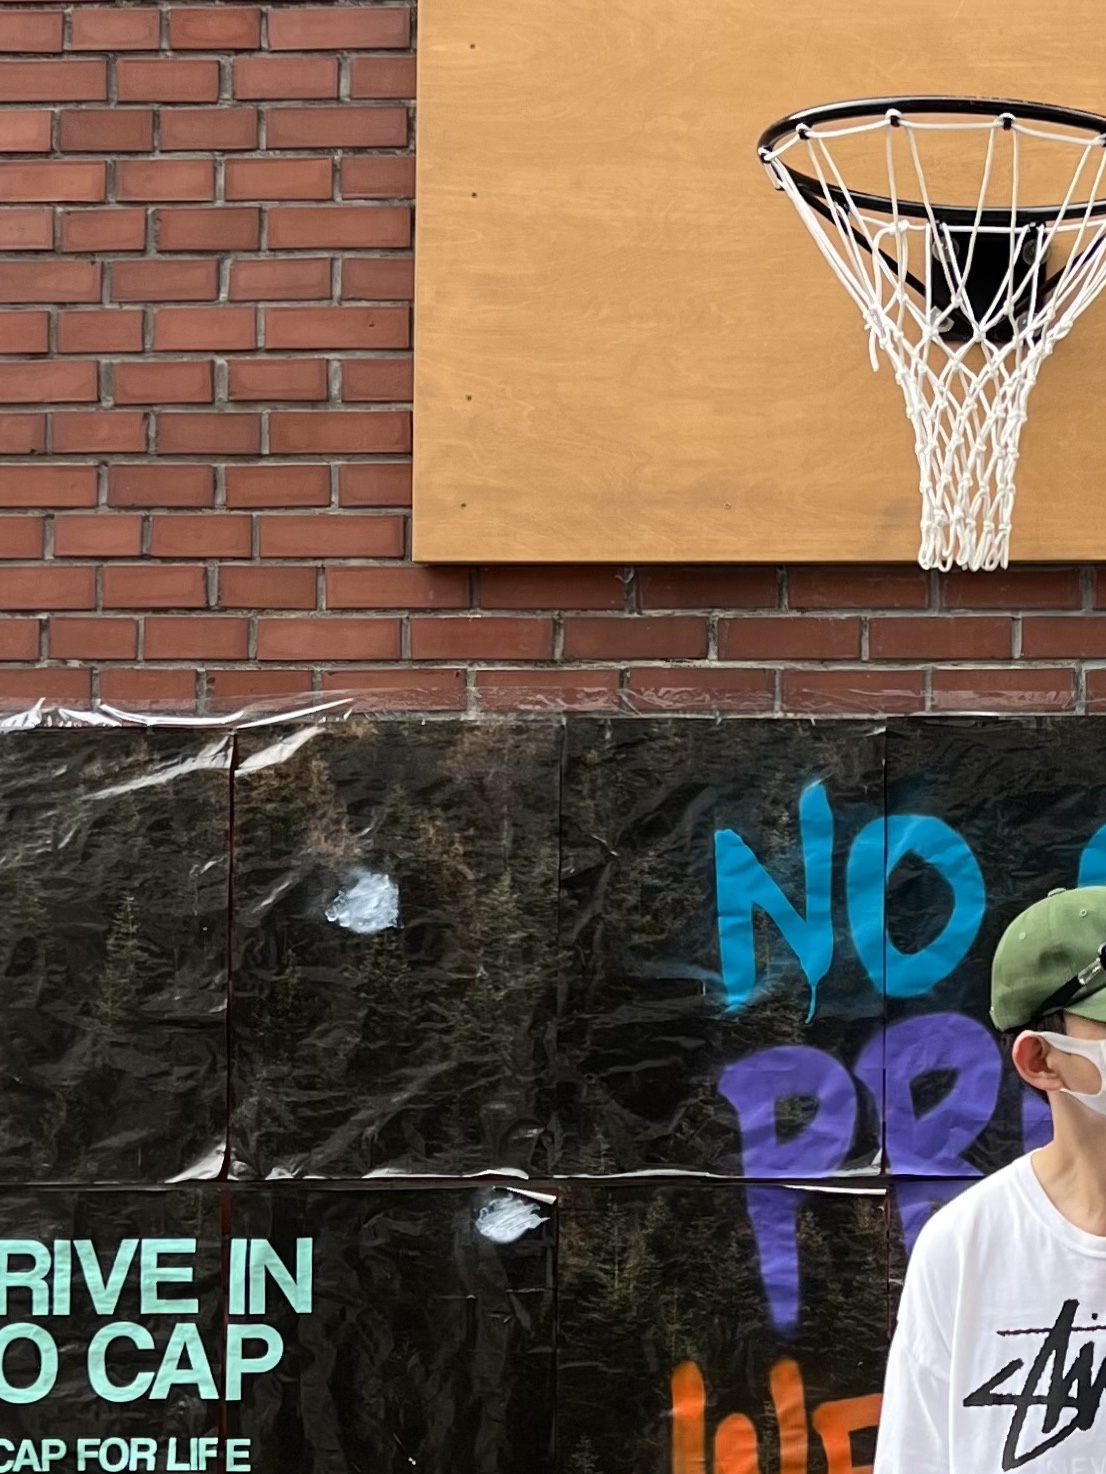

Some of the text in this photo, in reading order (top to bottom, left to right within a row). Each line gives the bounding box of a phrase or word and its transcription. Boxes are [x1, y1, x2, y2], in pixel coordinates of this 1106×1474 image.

[713, 782, 986, 1024] NO
[0, 1237, 313, 1316] RIVE IN
[87, 1321, 284, 1403] CAP
[0, 1437, 252, 1474] CAP FOR LIFE
